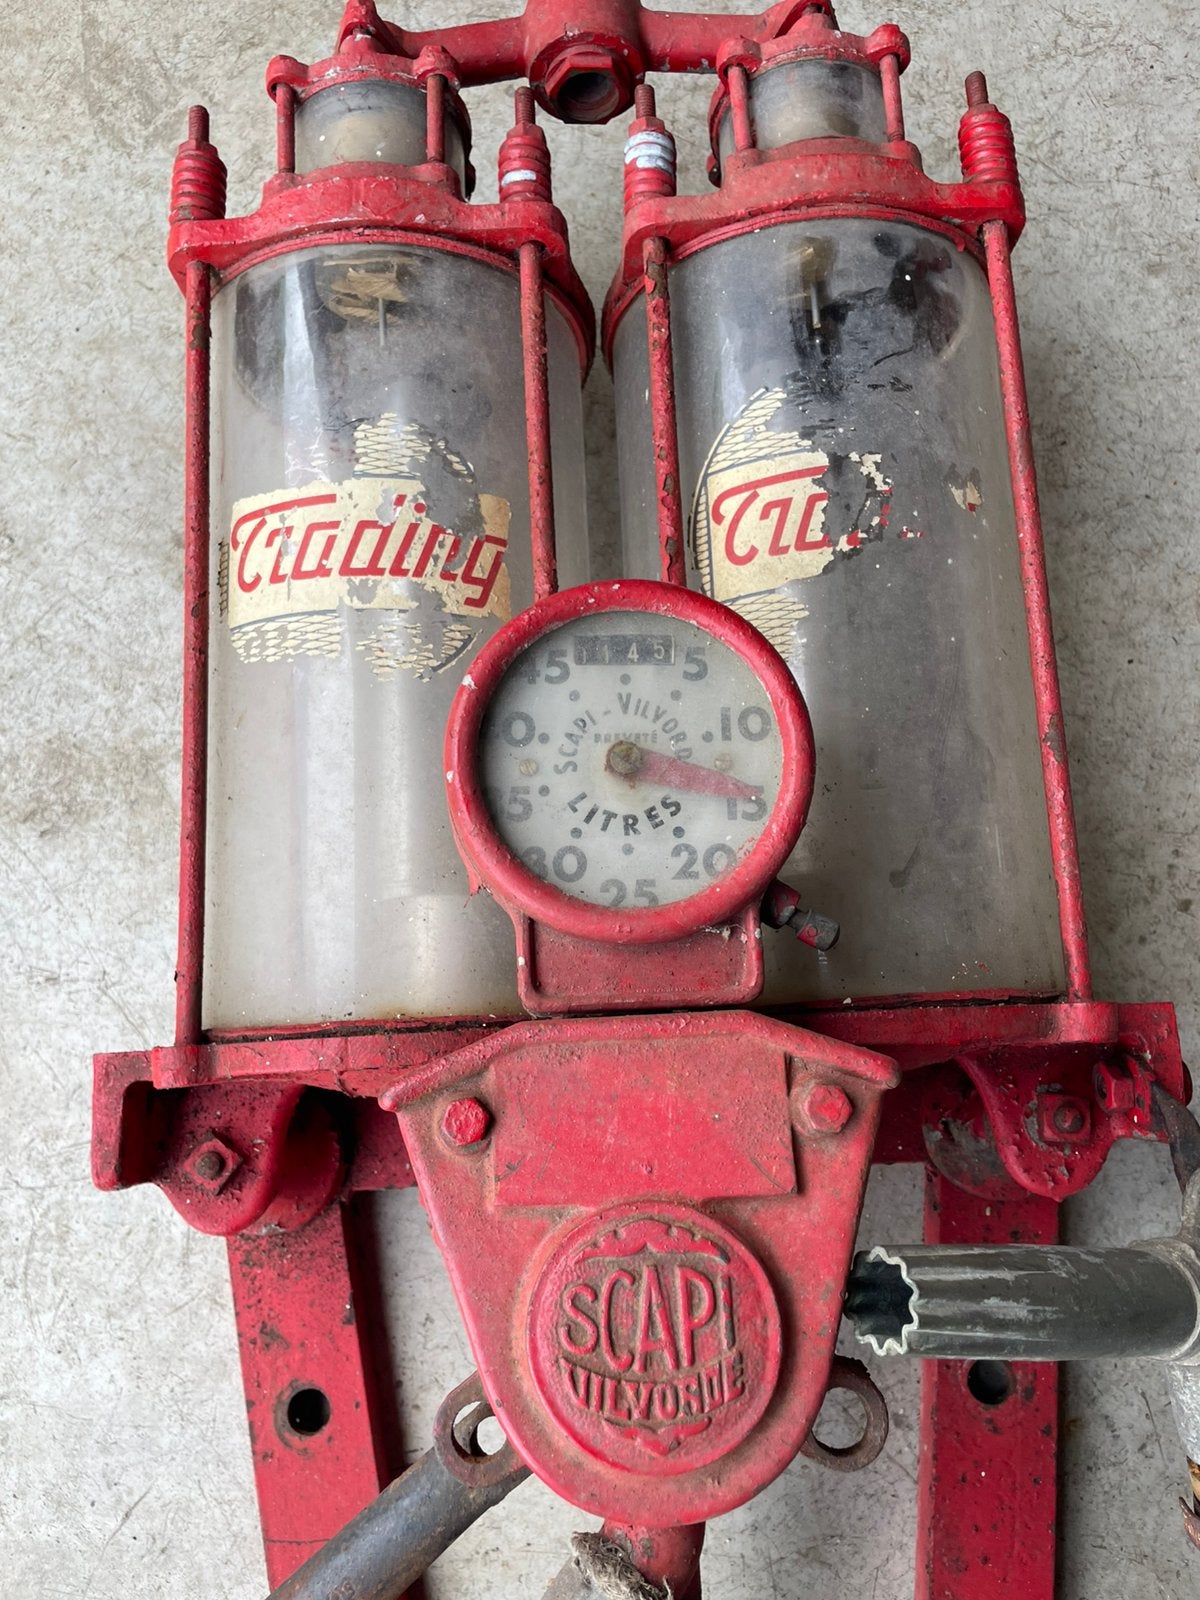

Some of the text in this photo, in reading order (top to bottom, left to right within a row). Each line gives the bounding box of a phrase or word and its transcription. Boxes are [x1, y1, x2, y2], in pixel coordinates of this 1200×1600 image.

[231, 494, 508, 609] Trading
[682, 646, 709, 682] 5
[553, 692, 693, 775] SCAPI VILVORD
[720, 706, 772, 742] 10
[567, 792, 682, 836] LITRES
[726, 785, 768, 822] 15
[671, 843, 737, 881] 20
[600, 879, 659, 908] 25
[559, 1264, 736, 1373] SCAPI
